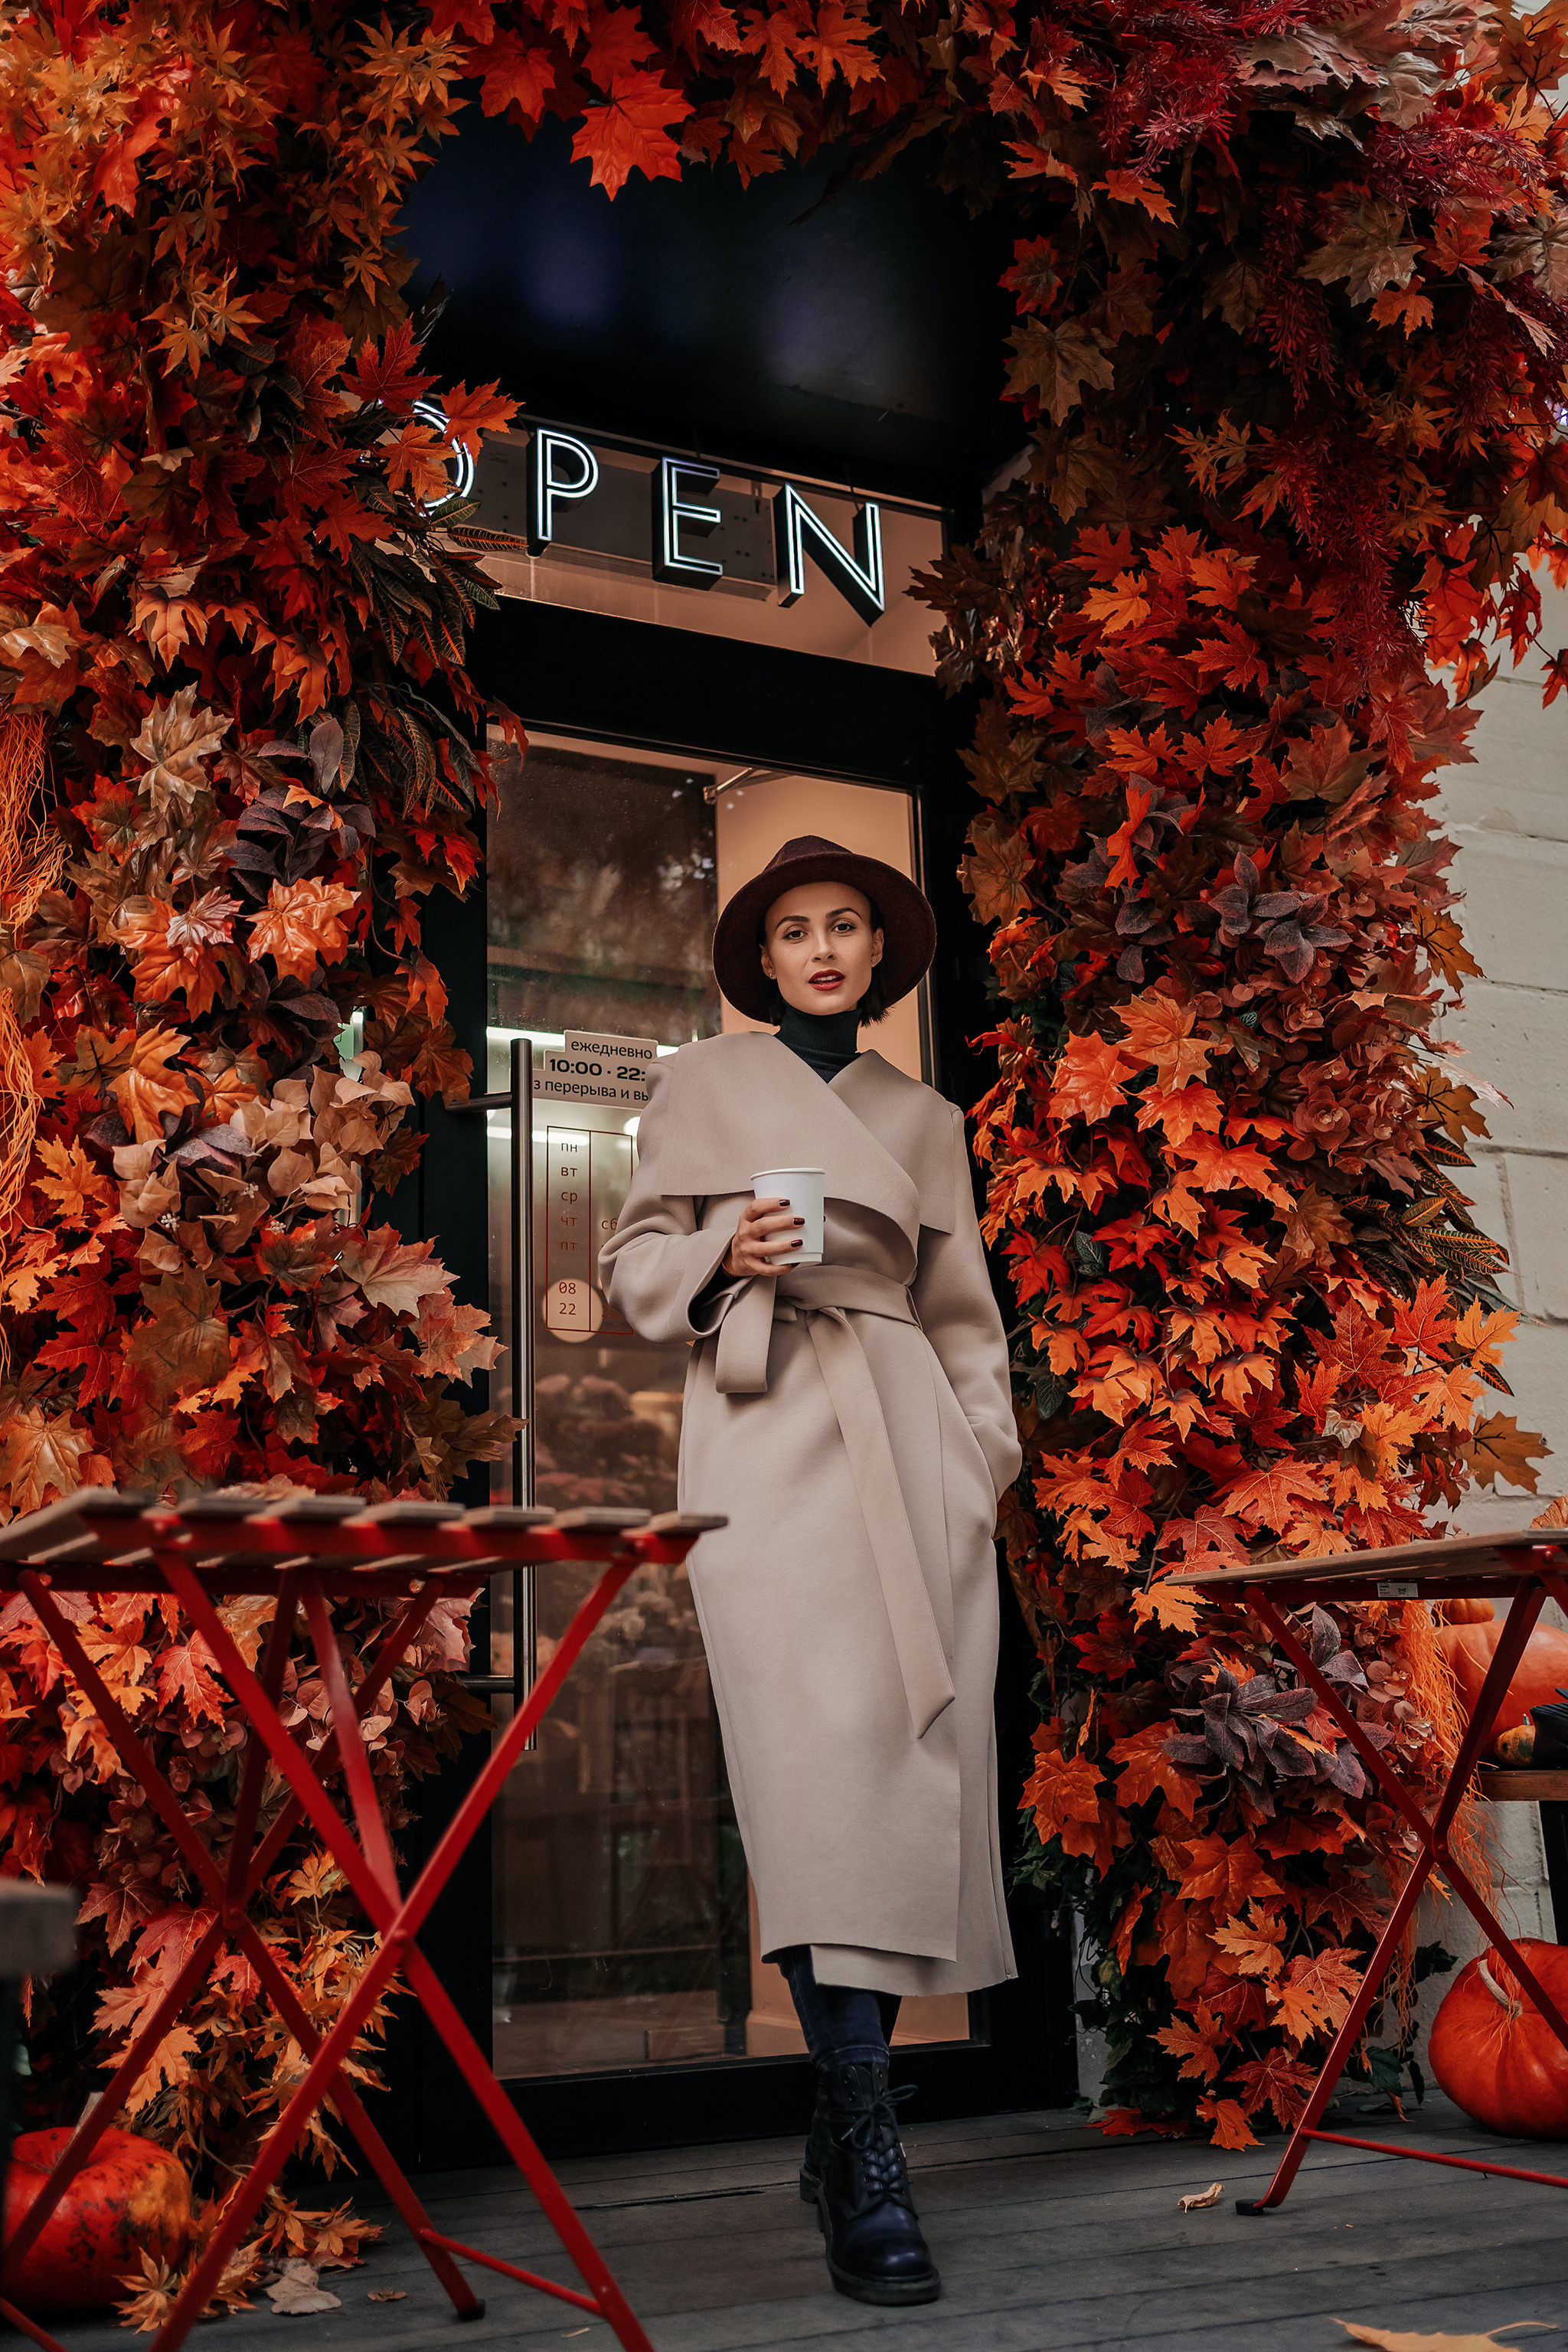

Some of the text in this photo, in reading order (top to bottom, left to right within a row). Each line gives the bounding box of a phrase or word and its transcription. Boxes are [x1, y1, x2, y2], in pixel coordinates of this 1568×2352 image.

[571, 1040, 653, 1060] ежедневно
[549, 1058, 603, 1076] 10:00
[545, 1080, 616, 1098] перерыва
[621, 1089, 629, 1099] и
[560, 1143, 578, 1153] пн
[560, 1167, 578, 1178] вт
[560, 1191, 578, 1205] ср
[560, 1216, 578, 1227] чт
[601, 1218, 618, 1230] сб
[560, 1241, 578, 1252] пт
[559, 1282, 577, 1295] 08
[559, 1302, 577, 1315] 22
